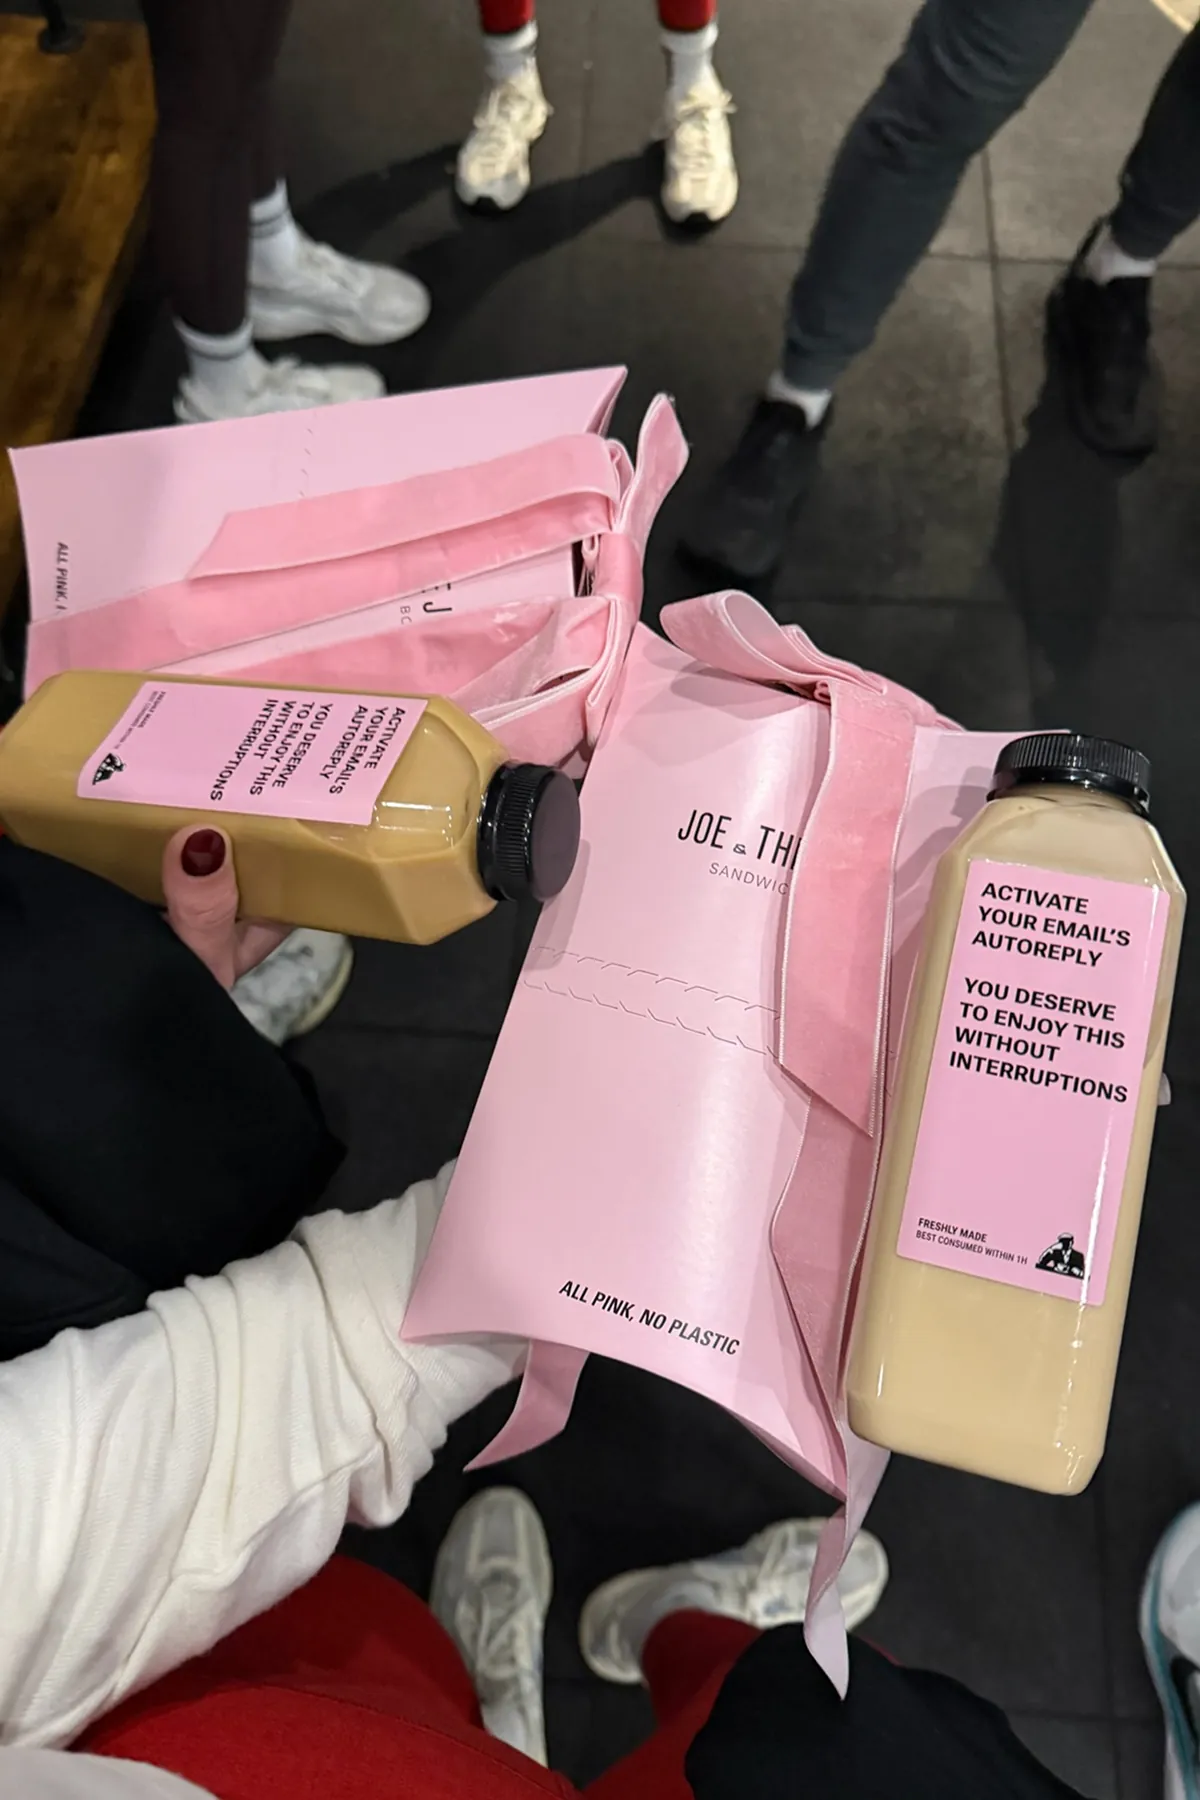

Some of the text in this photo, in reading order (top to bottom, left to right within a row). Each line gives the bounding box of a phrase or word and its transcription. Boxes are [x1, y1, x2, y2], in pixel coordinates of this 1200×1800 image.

[57, 542, 69, 564] ALL
[253, 700, 297, 760] WITHOUT
[272, 703, 334, 789] YOU DESERVE
[319, 705, 369, 780] AUTOREPLY
[359, 706, 389, 742] YOUR
[364, 707, 406, 770] ACTIVATE
[210, 698, 279, 801] INTERRUPTIONS
[249, 701, 316, 796] TO ENJOY THIS
[677, 809, 732, 849] JOE
[732, 843, 747, 855] &
[708, 862, 790, 896] SANDWIC
[981, 882, 1089, 914] ACTIVATE
[978, 905, 1038, 931] YOUR
[971, 930, 1103, 967] AUTOREPLY
[964, 977, 1117, 1021] YOU DESERVE
[954, 1025, 1060, 1062] WITHOUT
[959, 1001, 1126, 1049] TO ENJOY THIS
[949, 1050, 1128, 1103] INTERRUPTIONS
[915, 1229, 1029, 1266] BEST CONSUMED WITHIN 1H
[918, 1217, 988, 1243] FRESHLY MADE
[558, 1279, 741, 1356] ALL PINK, NO PLASTIC
